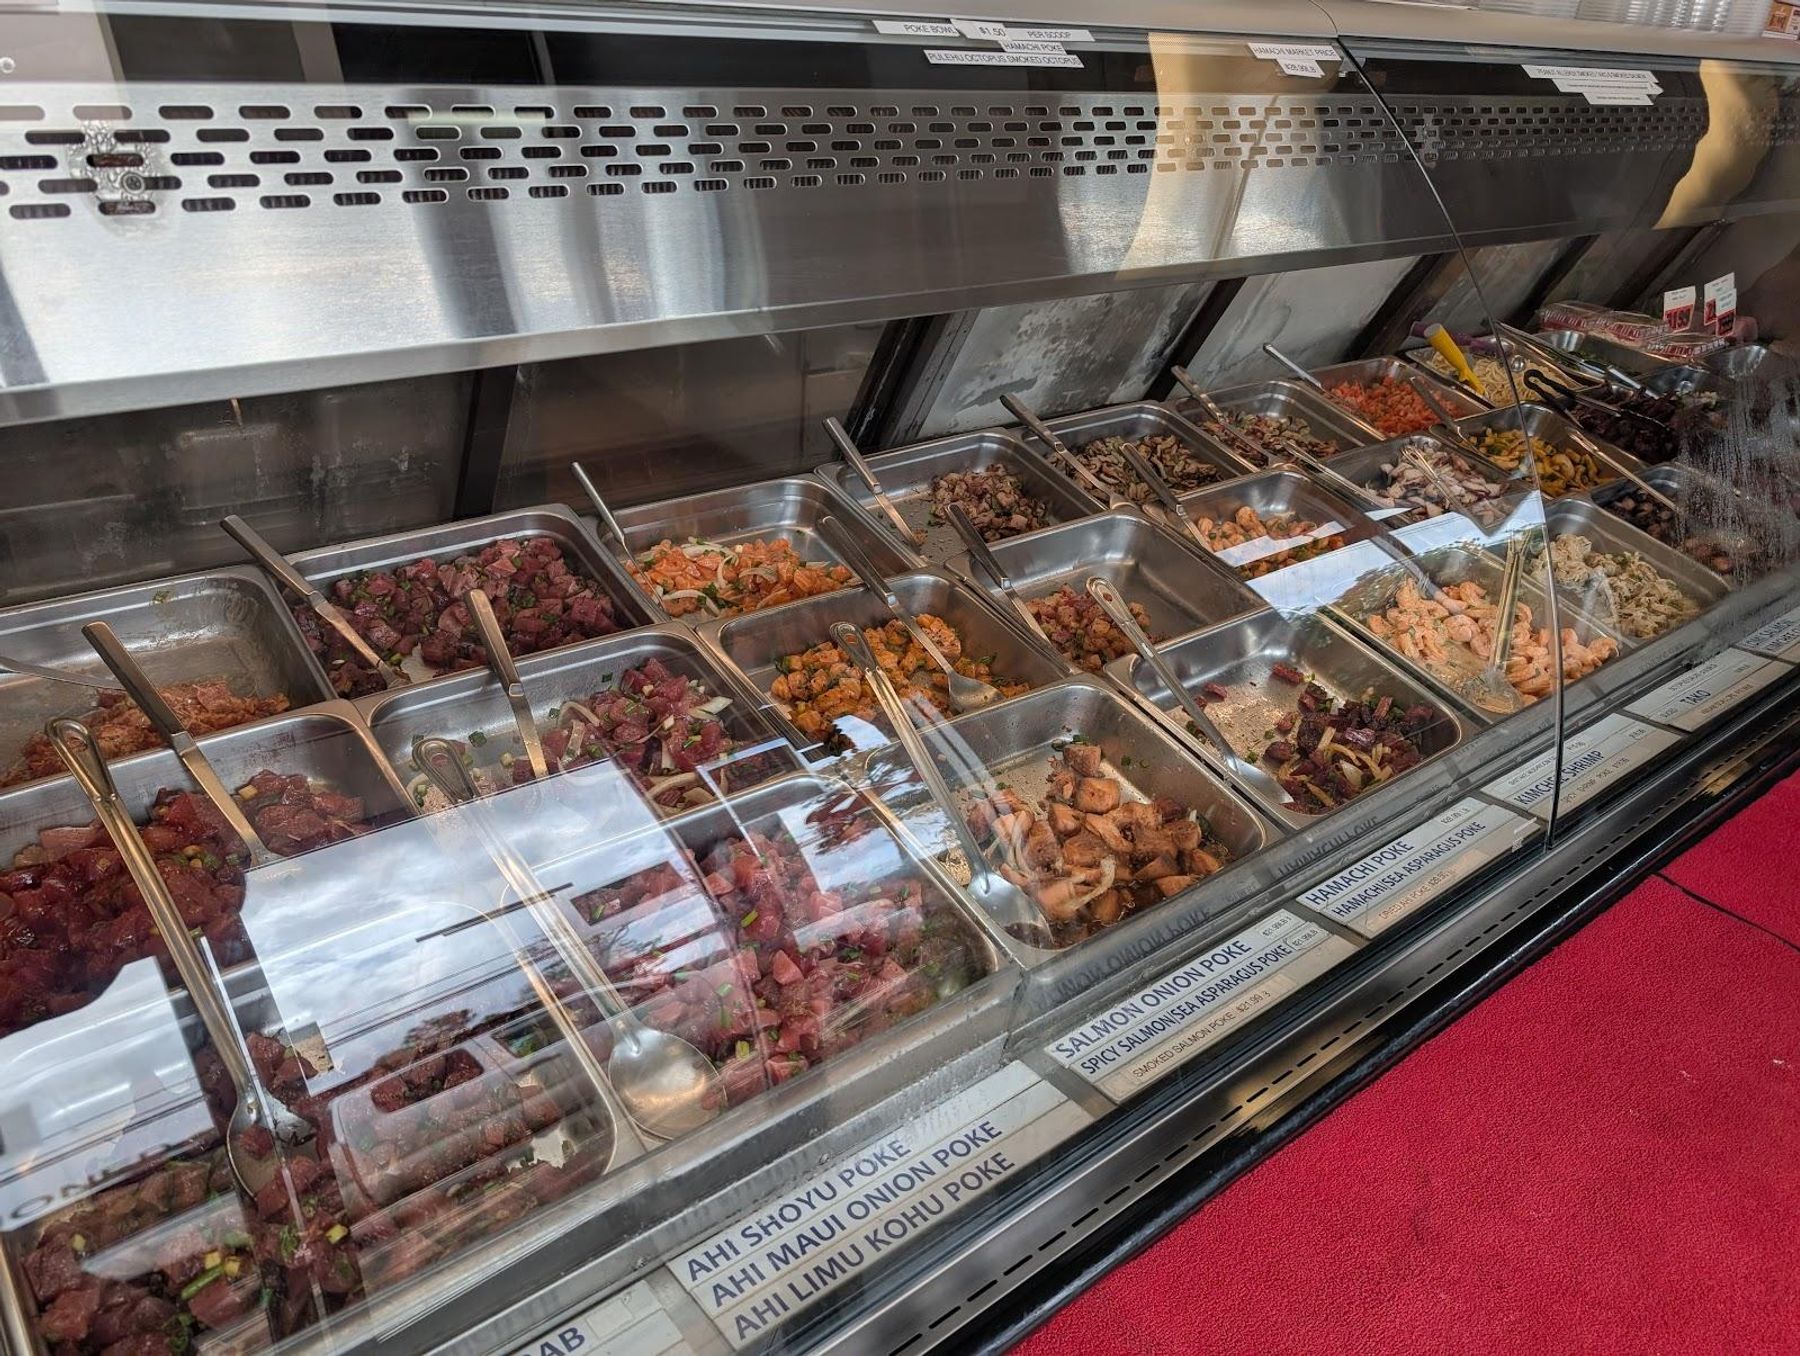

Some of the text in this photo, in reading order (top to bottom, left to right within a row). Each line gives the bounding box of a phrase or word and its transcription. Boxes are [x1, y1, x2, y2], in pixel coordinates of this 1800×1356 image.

[904, 24, 957, 34] POKE BOWL
[979, 27, 1006, 37] $1.50
[1680, 689, 1711, 706] TAKO
[1561, 750, 1605, 778] SHRIMP
[1305, 860, 1377, 906] HAMACHI
[1375, 840, 1414, 869] POKE
[1331, 821, 1486, 918] HAMACHI/SEA ASPARAGUS POKE
[1056, 1002, 1144, 1060] SALMON
[1142, 967, 1204, 1009] ONION
[1202, 940, 1252, 973] POKE
[1080, 944, 1293, 1075] SPICY SALMON/SEA ASPARAGUS POKE
[1132, 1050, 1174, 1078] SMOKED
[1172, 1027, 1211, 1054] SALMON
[1208, 1011, 1236, 1031] POKE
[687, 1140, 911, 1283] AHI SHOYU POKE
[711, 1120, 1003, 1307] AHI MAUI ONION POKE
[734, 1151, 1015, 1340] AHI LIMU KOHU POKE
